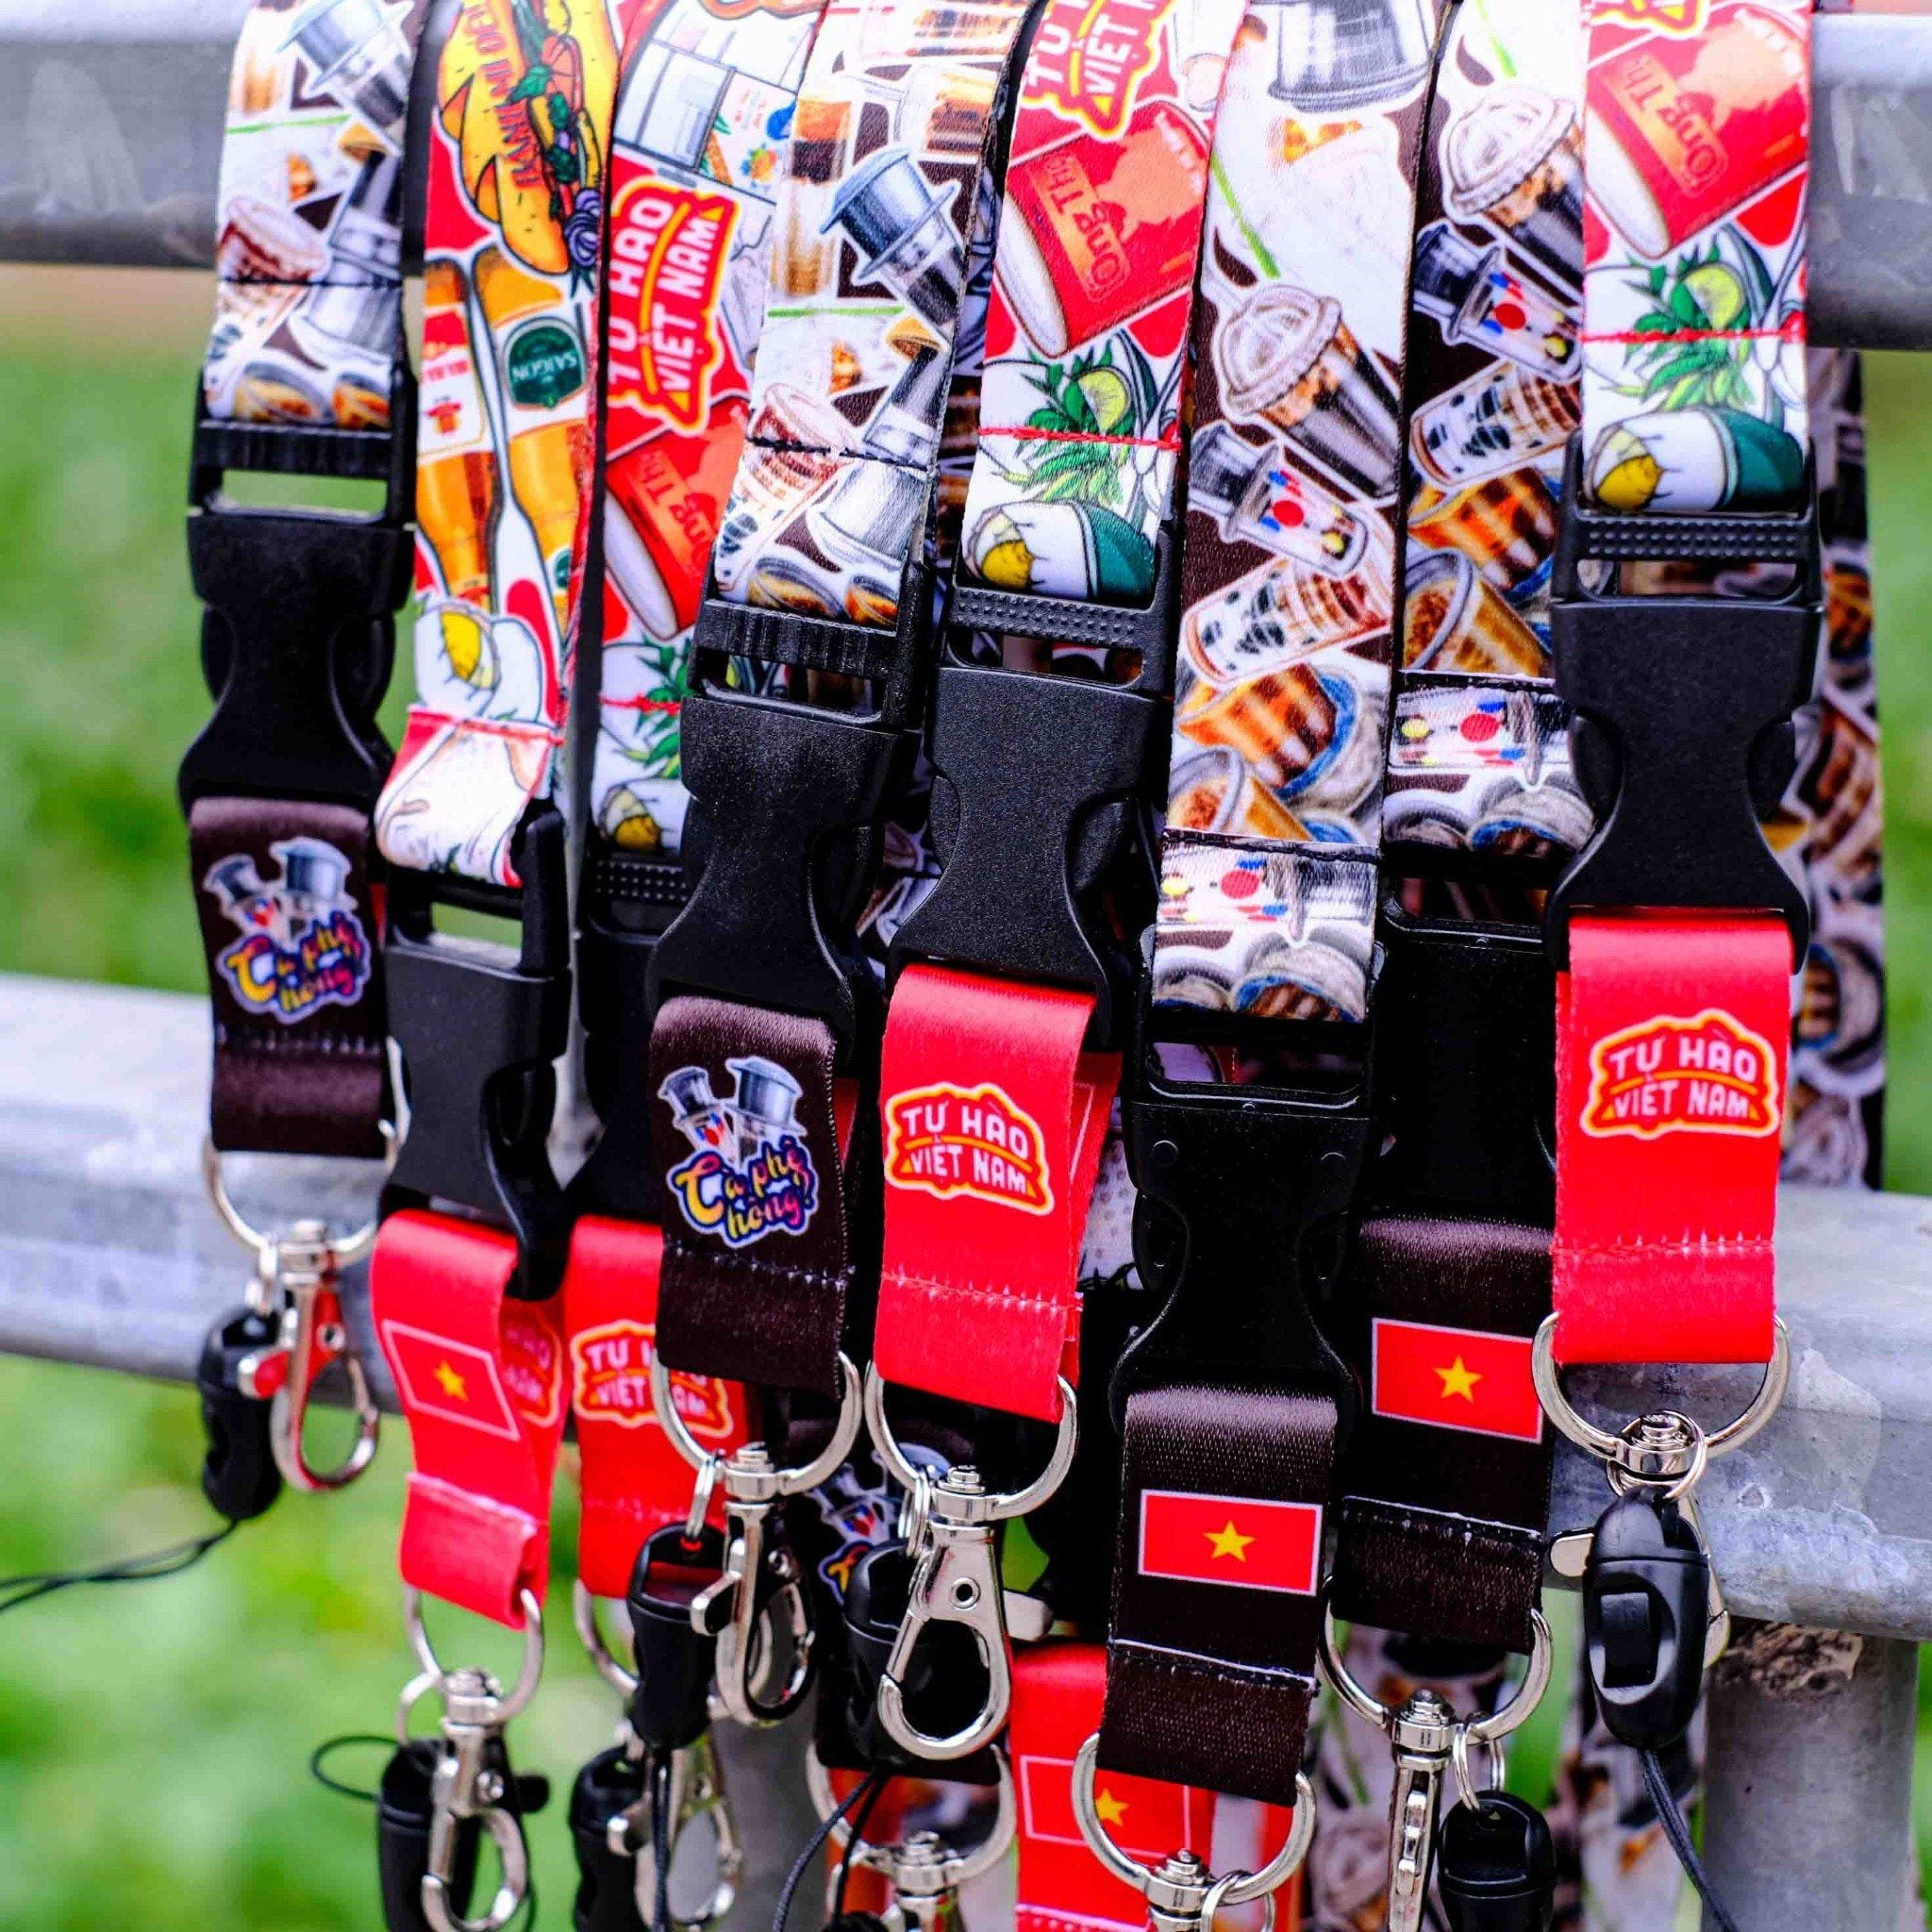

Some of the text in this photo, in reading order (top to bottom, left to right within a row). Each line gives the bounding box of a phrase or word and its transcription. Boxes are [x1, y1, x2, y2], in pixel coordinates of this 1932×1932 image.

[658, 217, 719, 300] NAM
[1678, 1028, 1757, 1084] HÀO
[1687, 1079, 1750, 1119] NAM
[961, 1100, 1029, 1160] HÀO
[973, 1147, 1027, 1195] NAM
